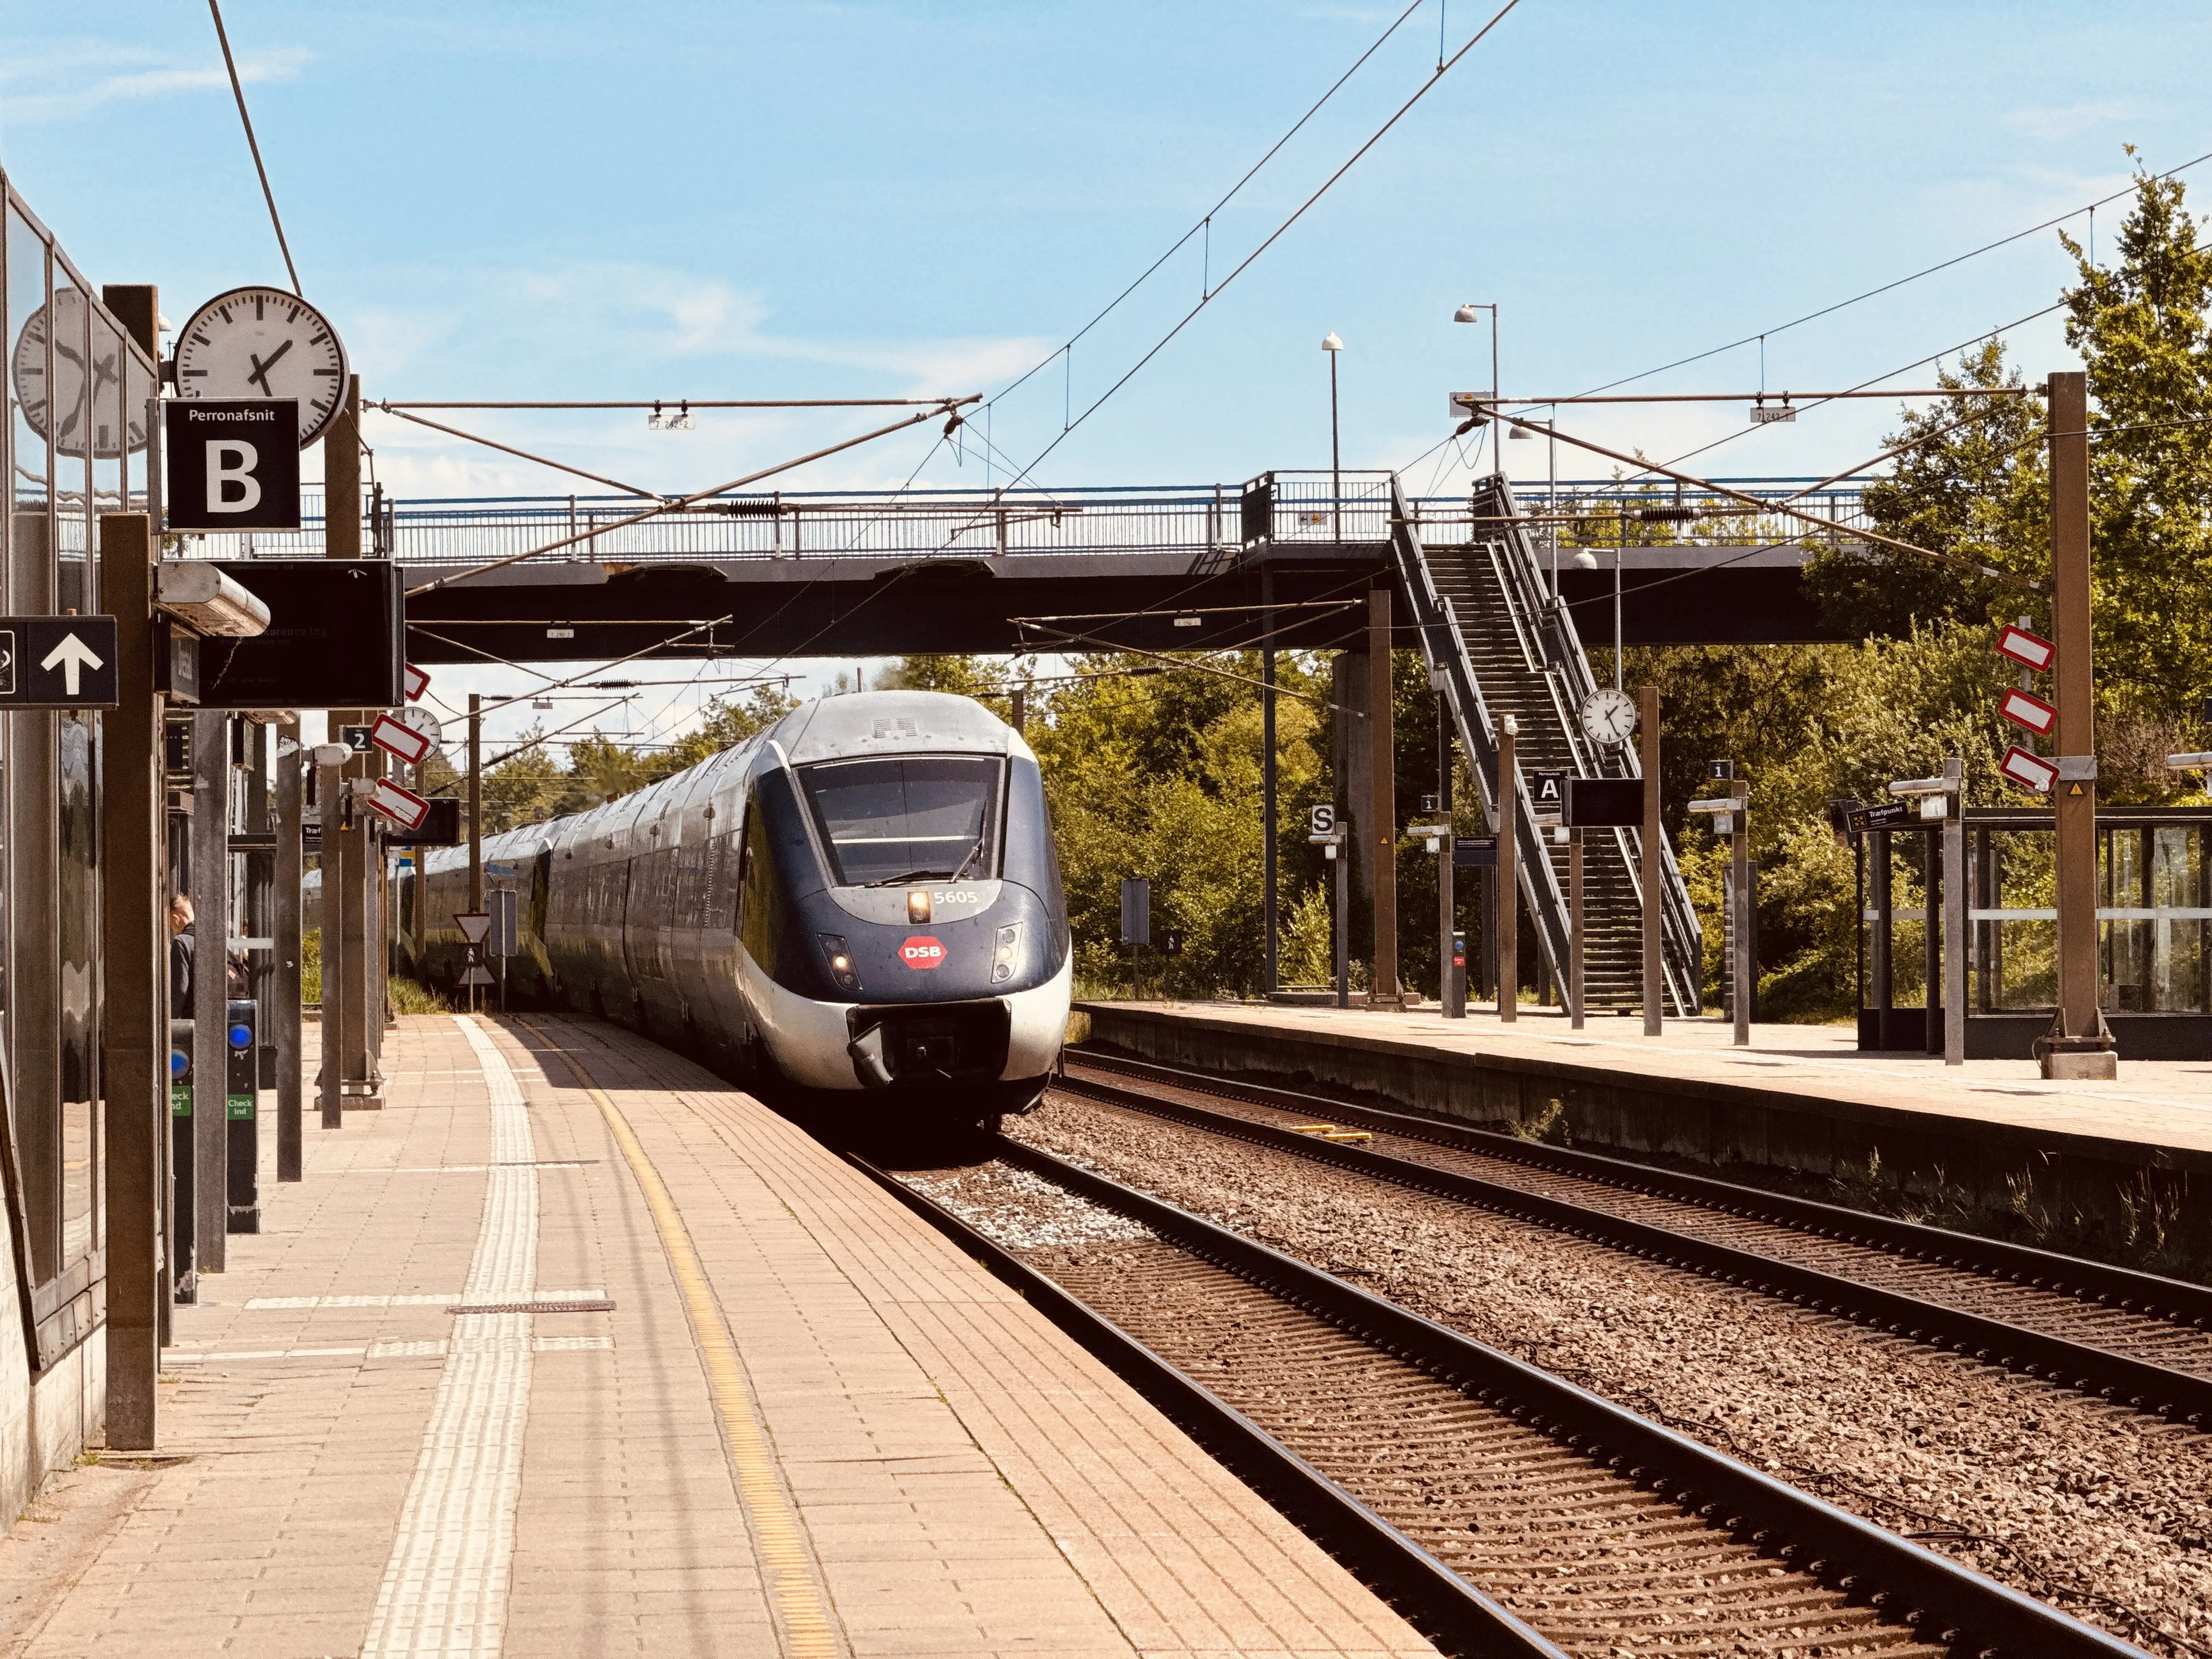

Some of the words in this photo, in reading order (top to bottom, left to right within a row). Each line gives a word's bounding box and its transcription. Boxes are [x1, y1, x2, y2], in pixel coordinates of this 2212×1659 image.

[189, 409, 275, 421] Perronafsnit
[206, 440, 261, 512] B
[354, 733, 365, 748] 2
[1716, 766, 1723, 777] 1
[1541, 779, 1559, 798] A
[1426, 800, 1432, 809] 1
[1313, 808, 1333, 832] S
[934, 891, 978, 904] 5605
[905, 946, 941, 958] DSB
[172, 1090, 189, 1100] eck
[171, 1102, 182, 1110] nd
